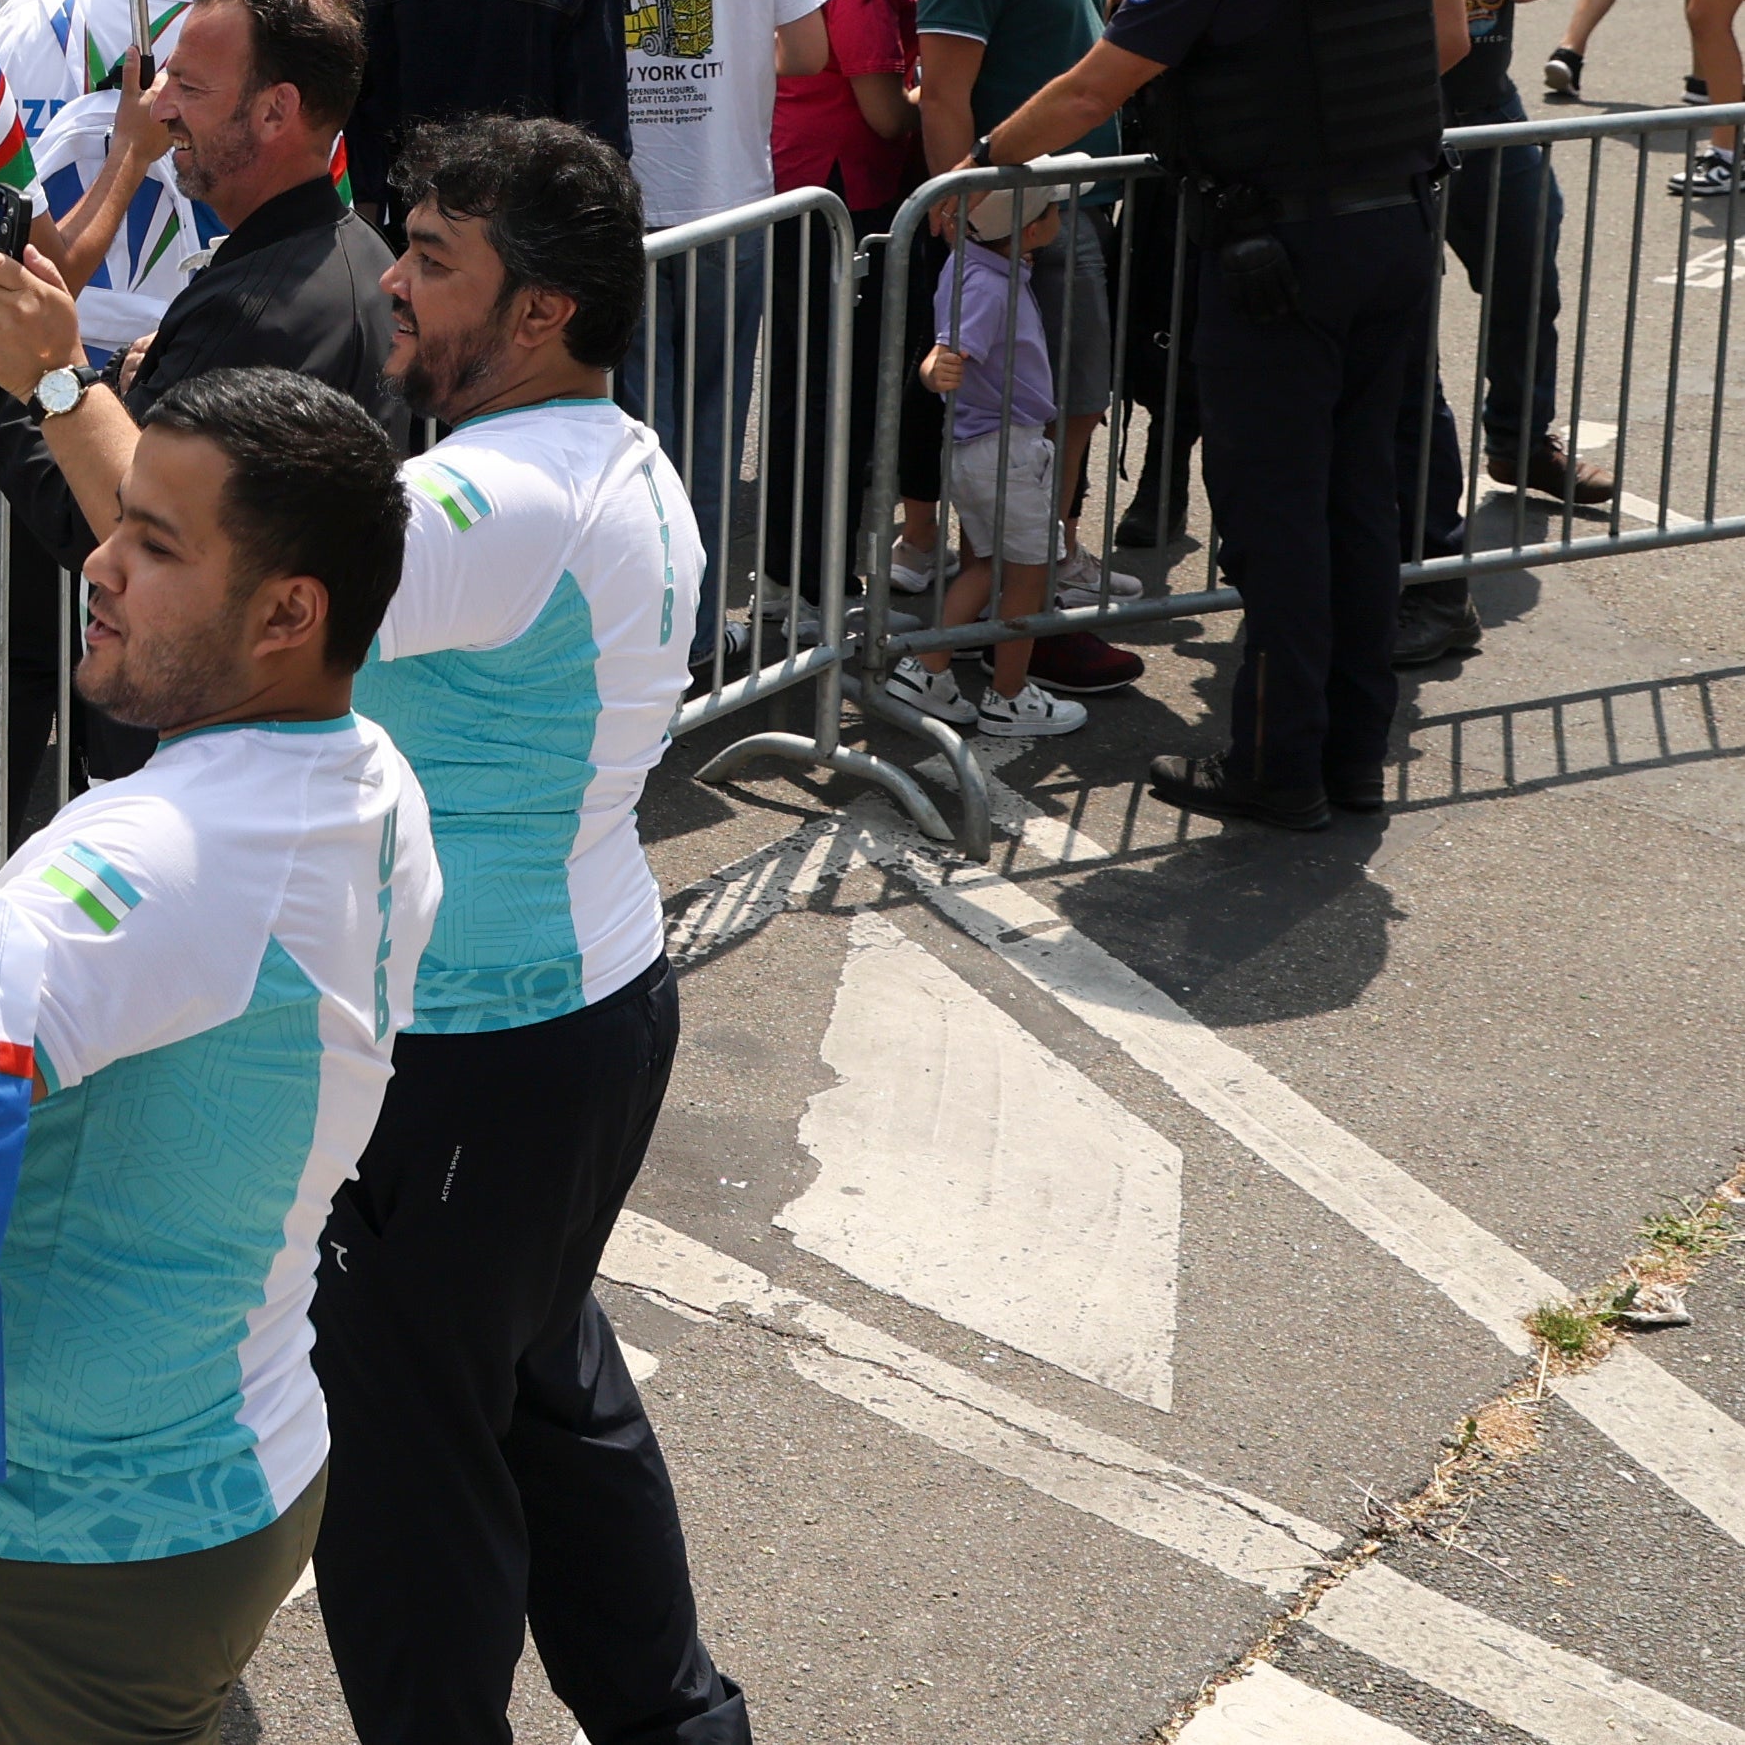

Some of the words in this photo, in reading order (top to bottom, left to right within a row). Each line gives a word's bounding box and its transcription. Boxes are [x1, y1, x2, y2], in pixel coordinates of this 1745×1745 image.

[636, 64, 687, 82] YORK
[691, 60, 724, 80] CITY
[628, 87, 665, 97] OPENING
[441, 1171, 455, 1202] ACTIVE
[450, 1145, 462, 1171] SPORT
